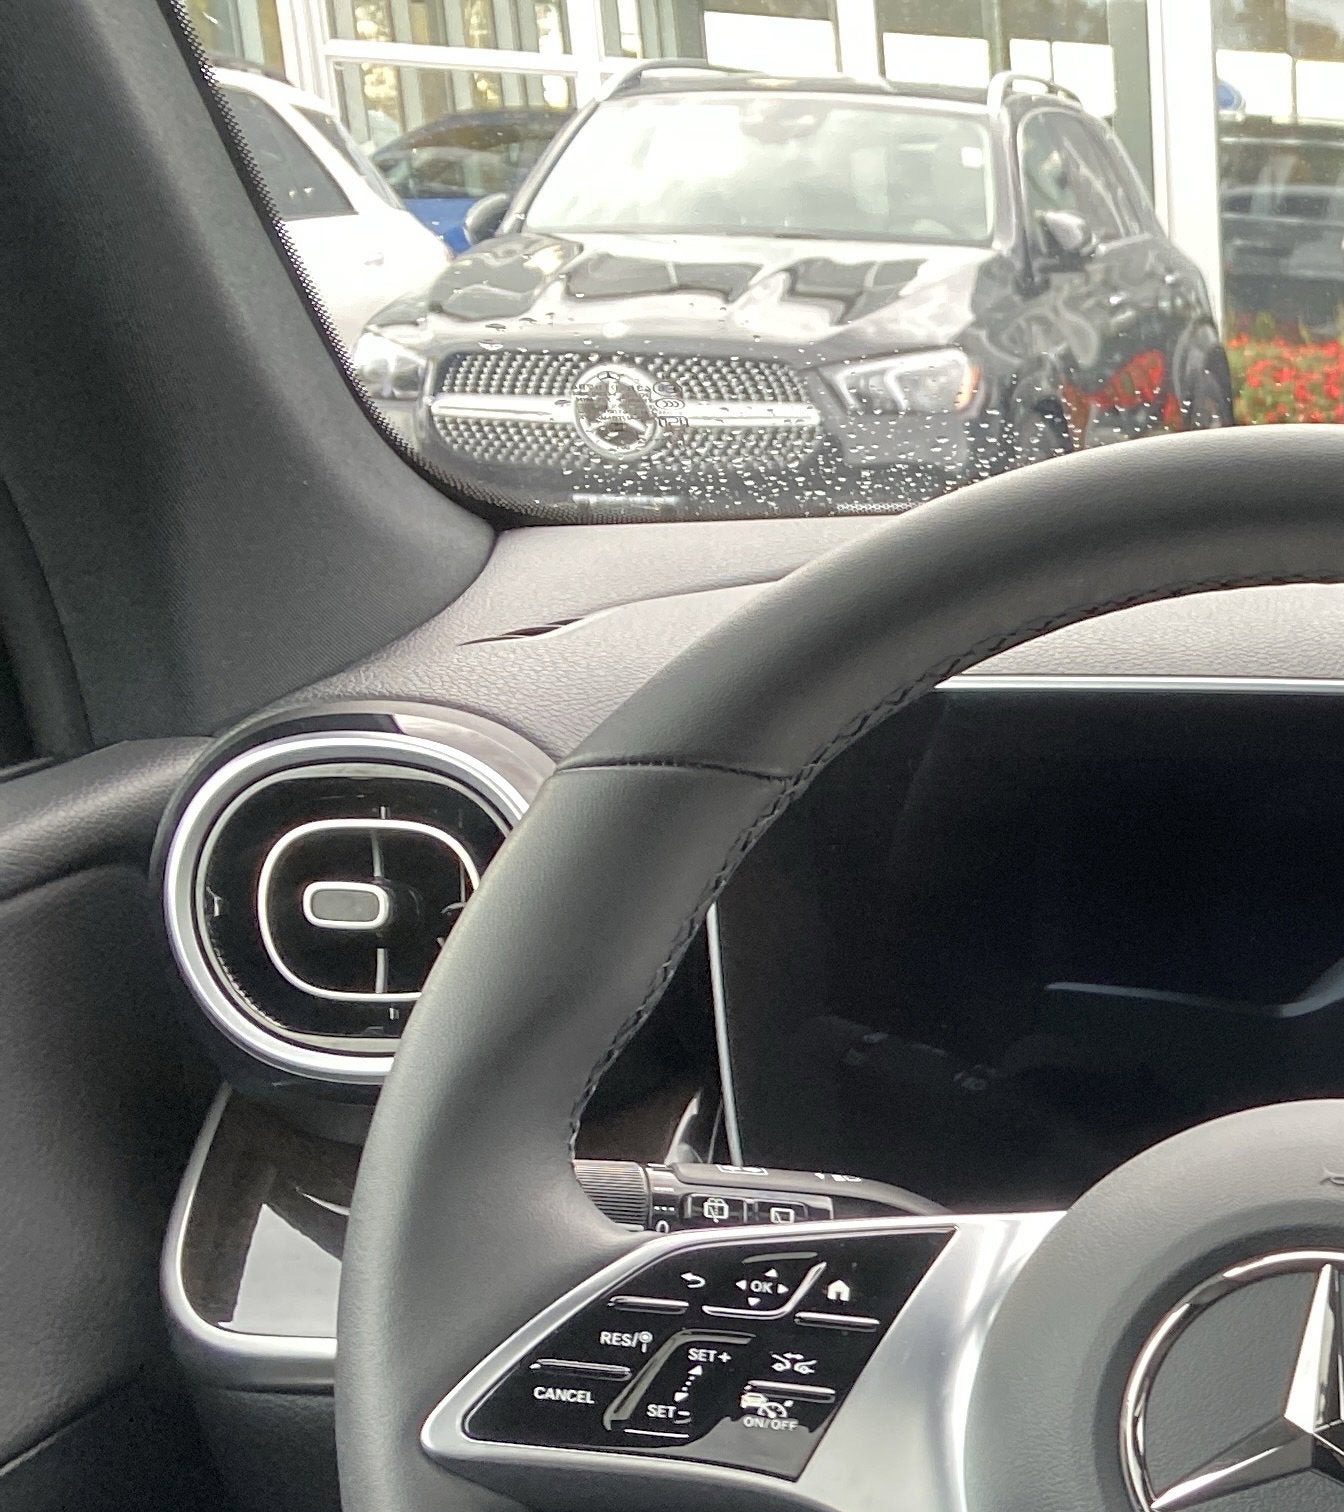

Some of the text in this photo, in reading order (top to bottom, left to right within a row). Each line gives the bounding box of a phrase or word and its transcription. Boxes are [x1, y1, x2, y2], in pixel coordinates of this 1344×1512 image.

[750, 1281, 774, 1294] OK
[533, 1387, 595, 1405] CANCEL
[743, 1416, 799, 1431] ON/OFF
